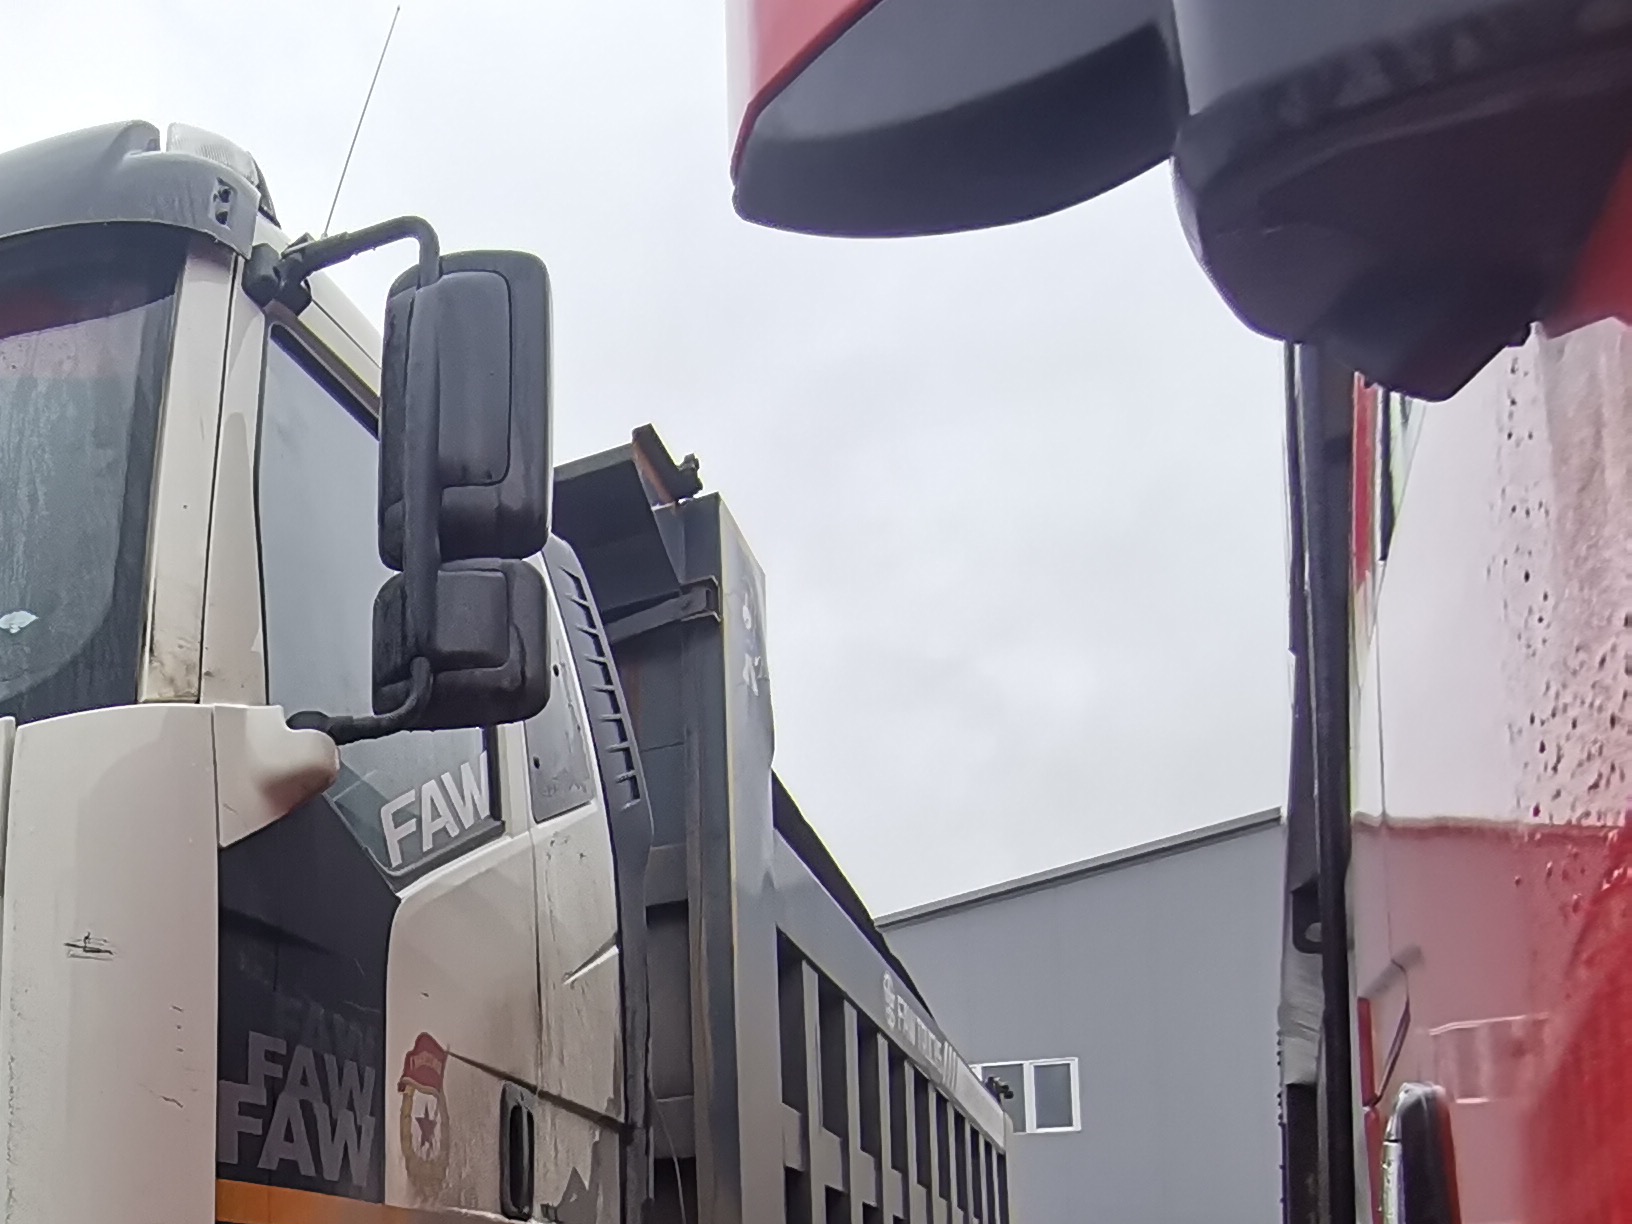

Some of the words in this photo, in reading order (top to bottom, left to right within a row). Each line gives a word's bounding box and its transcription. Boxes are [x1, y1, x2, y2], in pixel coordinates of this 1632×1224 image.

[380, 750, 490, 868] FAW
[248, 1030, 375, 1125] FAW
[217, 1080, 375, 1188] FAW
